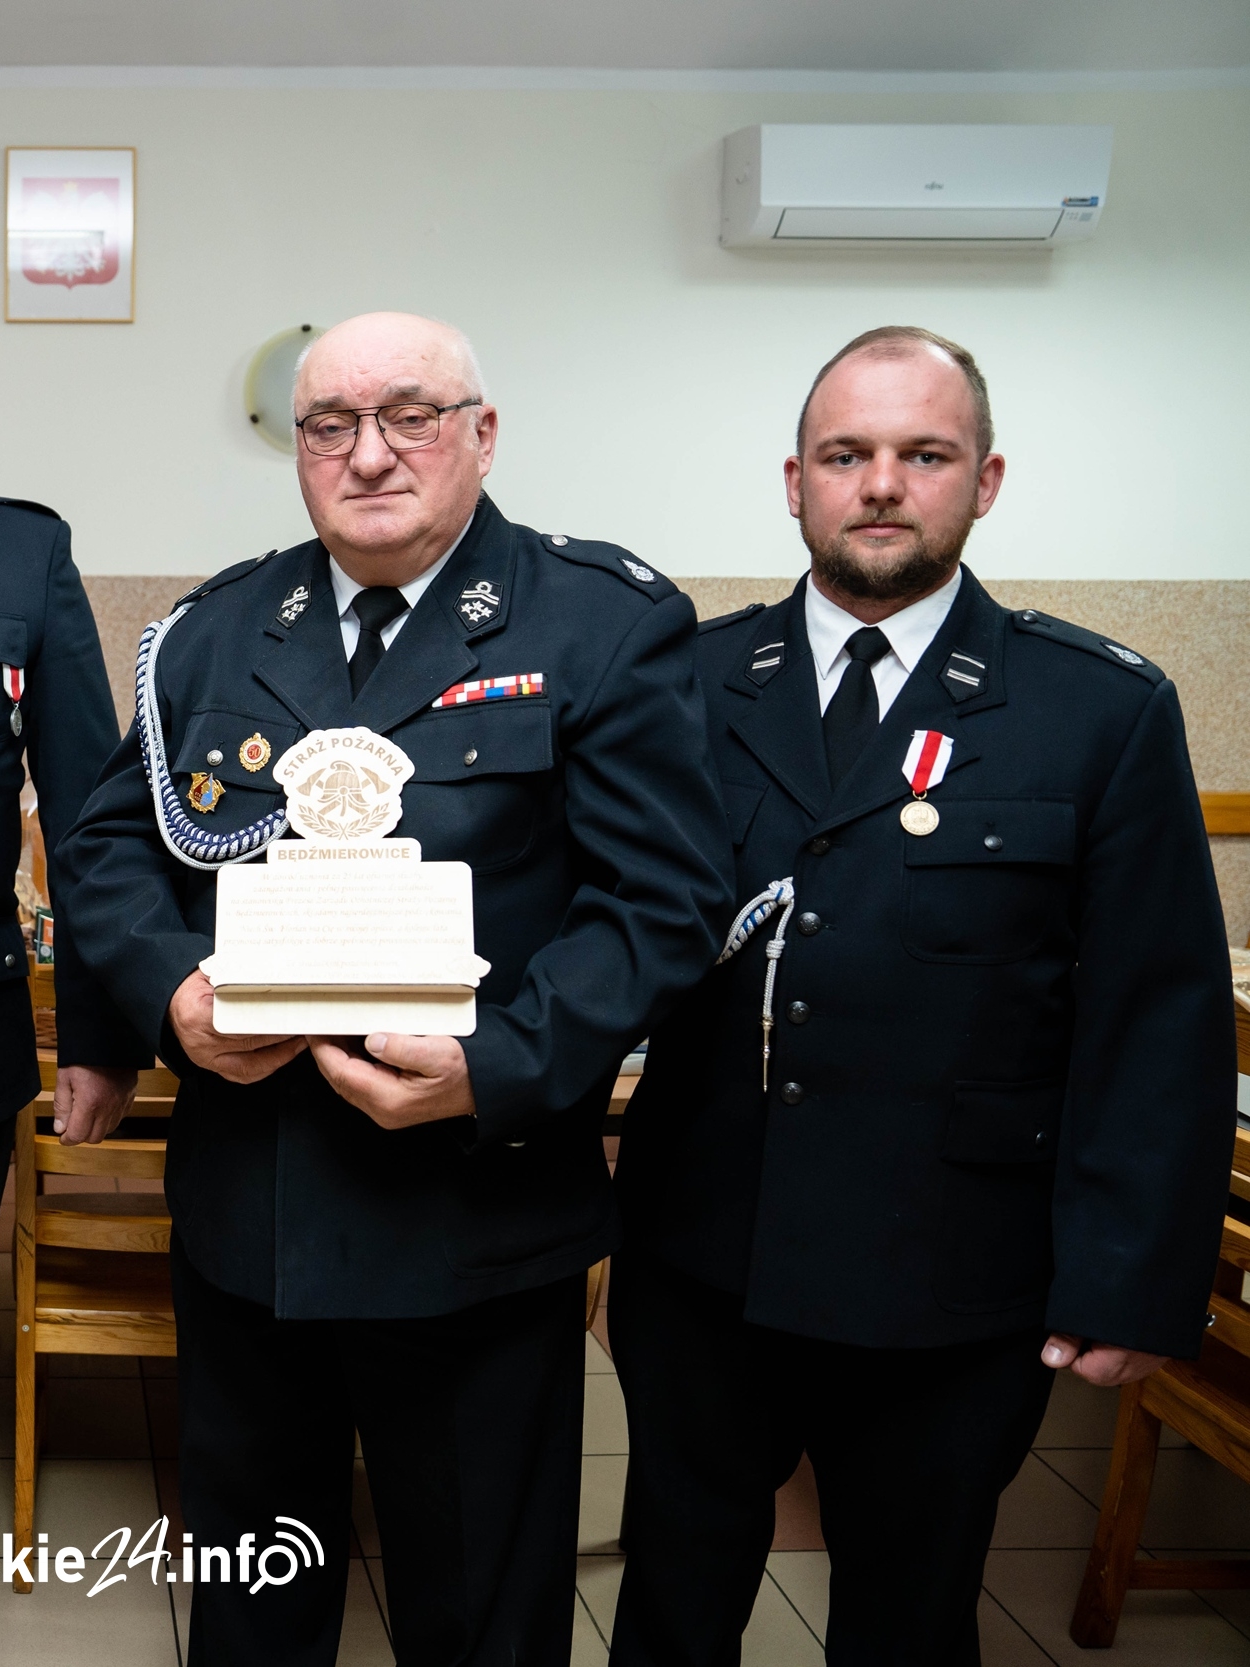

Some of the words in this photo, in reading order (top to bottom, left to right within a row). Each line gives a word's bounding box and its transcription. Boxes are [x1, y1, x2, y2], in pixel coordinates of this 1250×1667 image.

[283, 739, 327, 778] STRAŻ
[331, 736, 404, 776] POŻARNA
[277, 846, 410, 862] BĘDŹMIEROWICE
